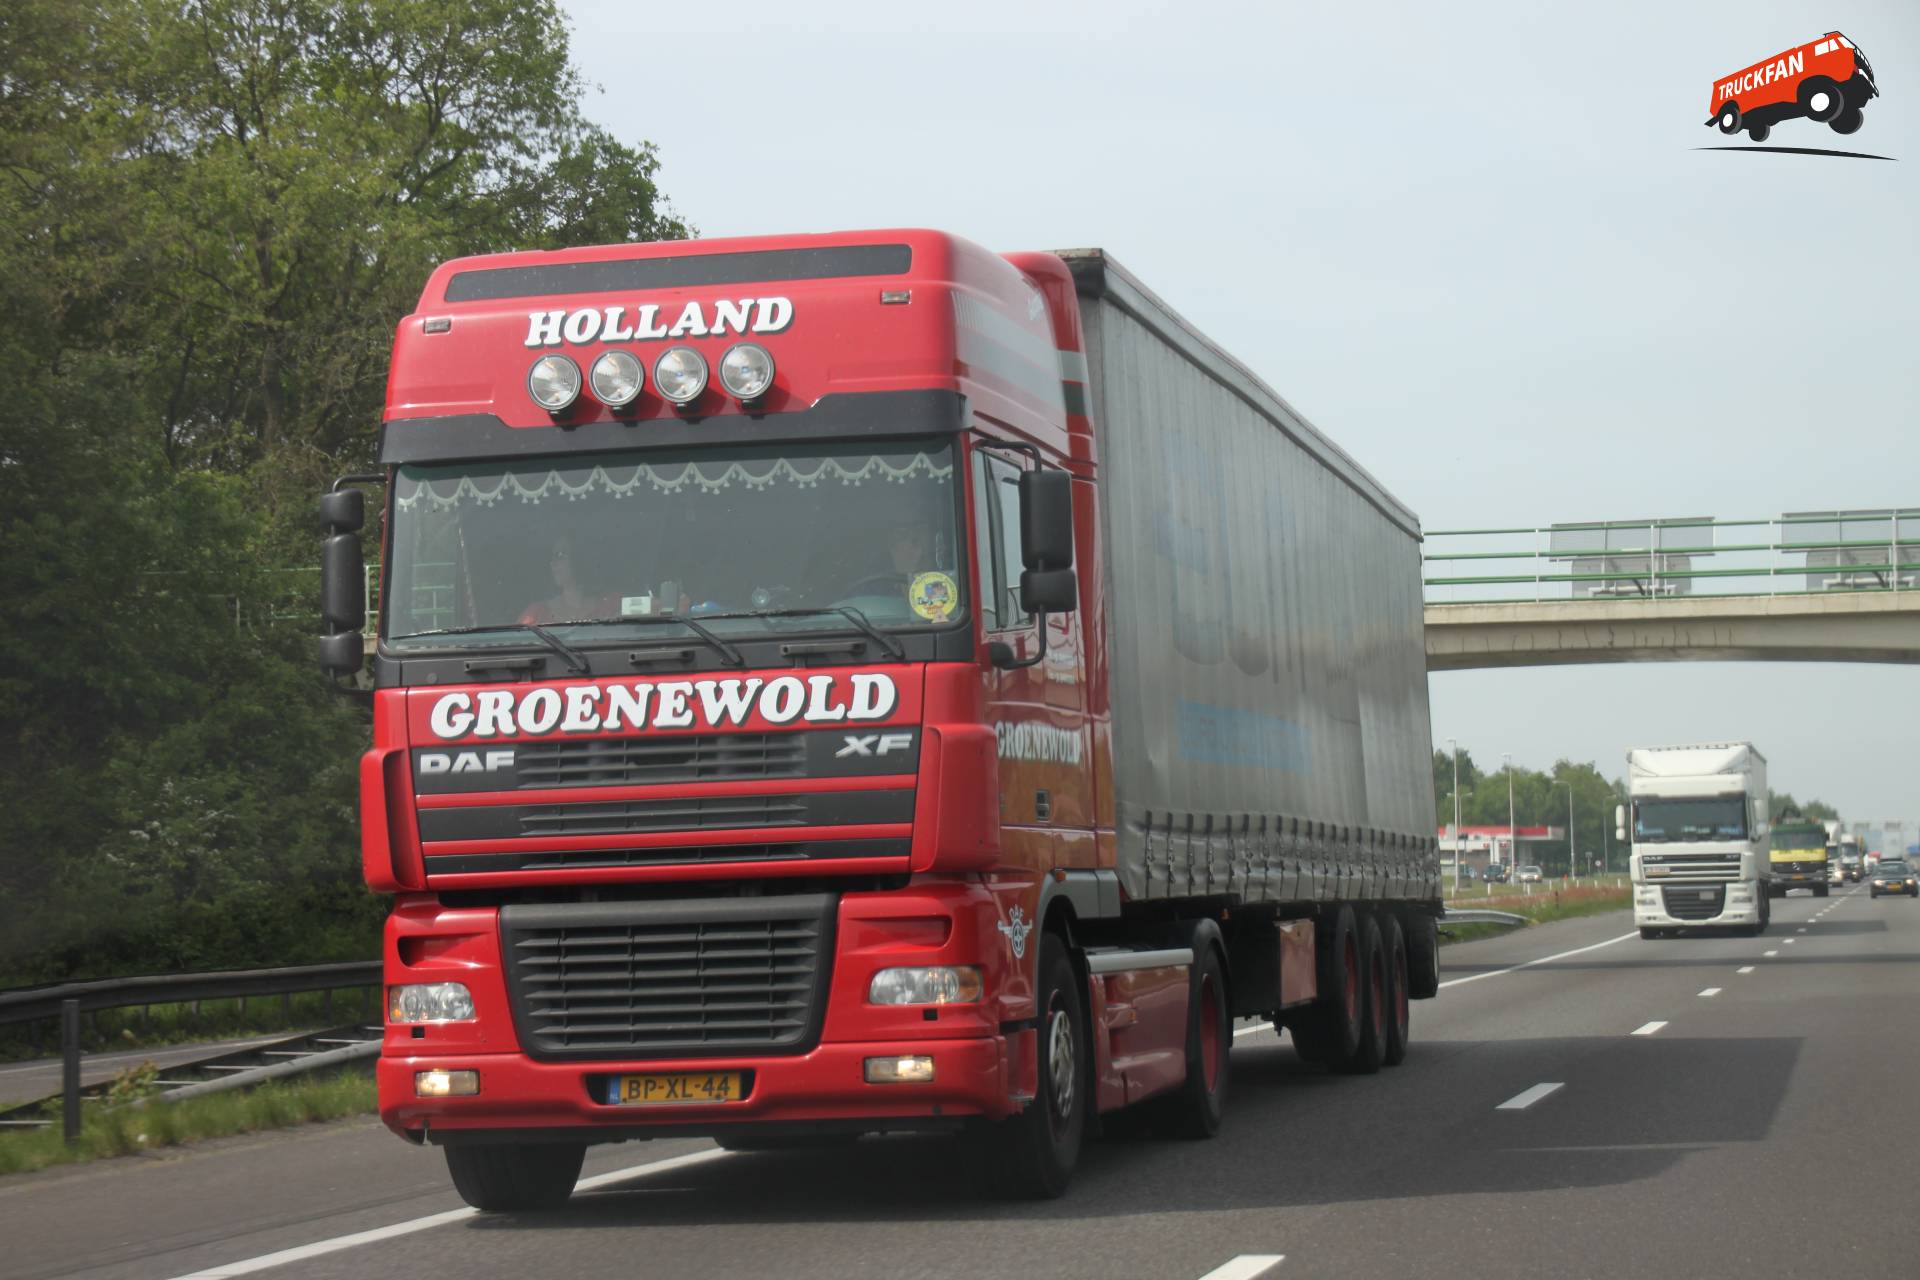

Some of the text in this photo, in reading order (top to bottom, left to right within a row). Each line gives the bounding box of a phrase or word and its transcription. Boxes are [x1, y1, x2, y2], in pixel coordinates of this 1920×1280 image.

[524, 296, 793, 347] HOLLAND
[430, 673, 898, 739] GROENEWOLD
[835, 733, 913, 758] XF
[994, 719, 1082, 765] GROENEWOLD
[420, 750, 515, 774] DAF
[627, 1076, 731, 1100] BP-XL-44
